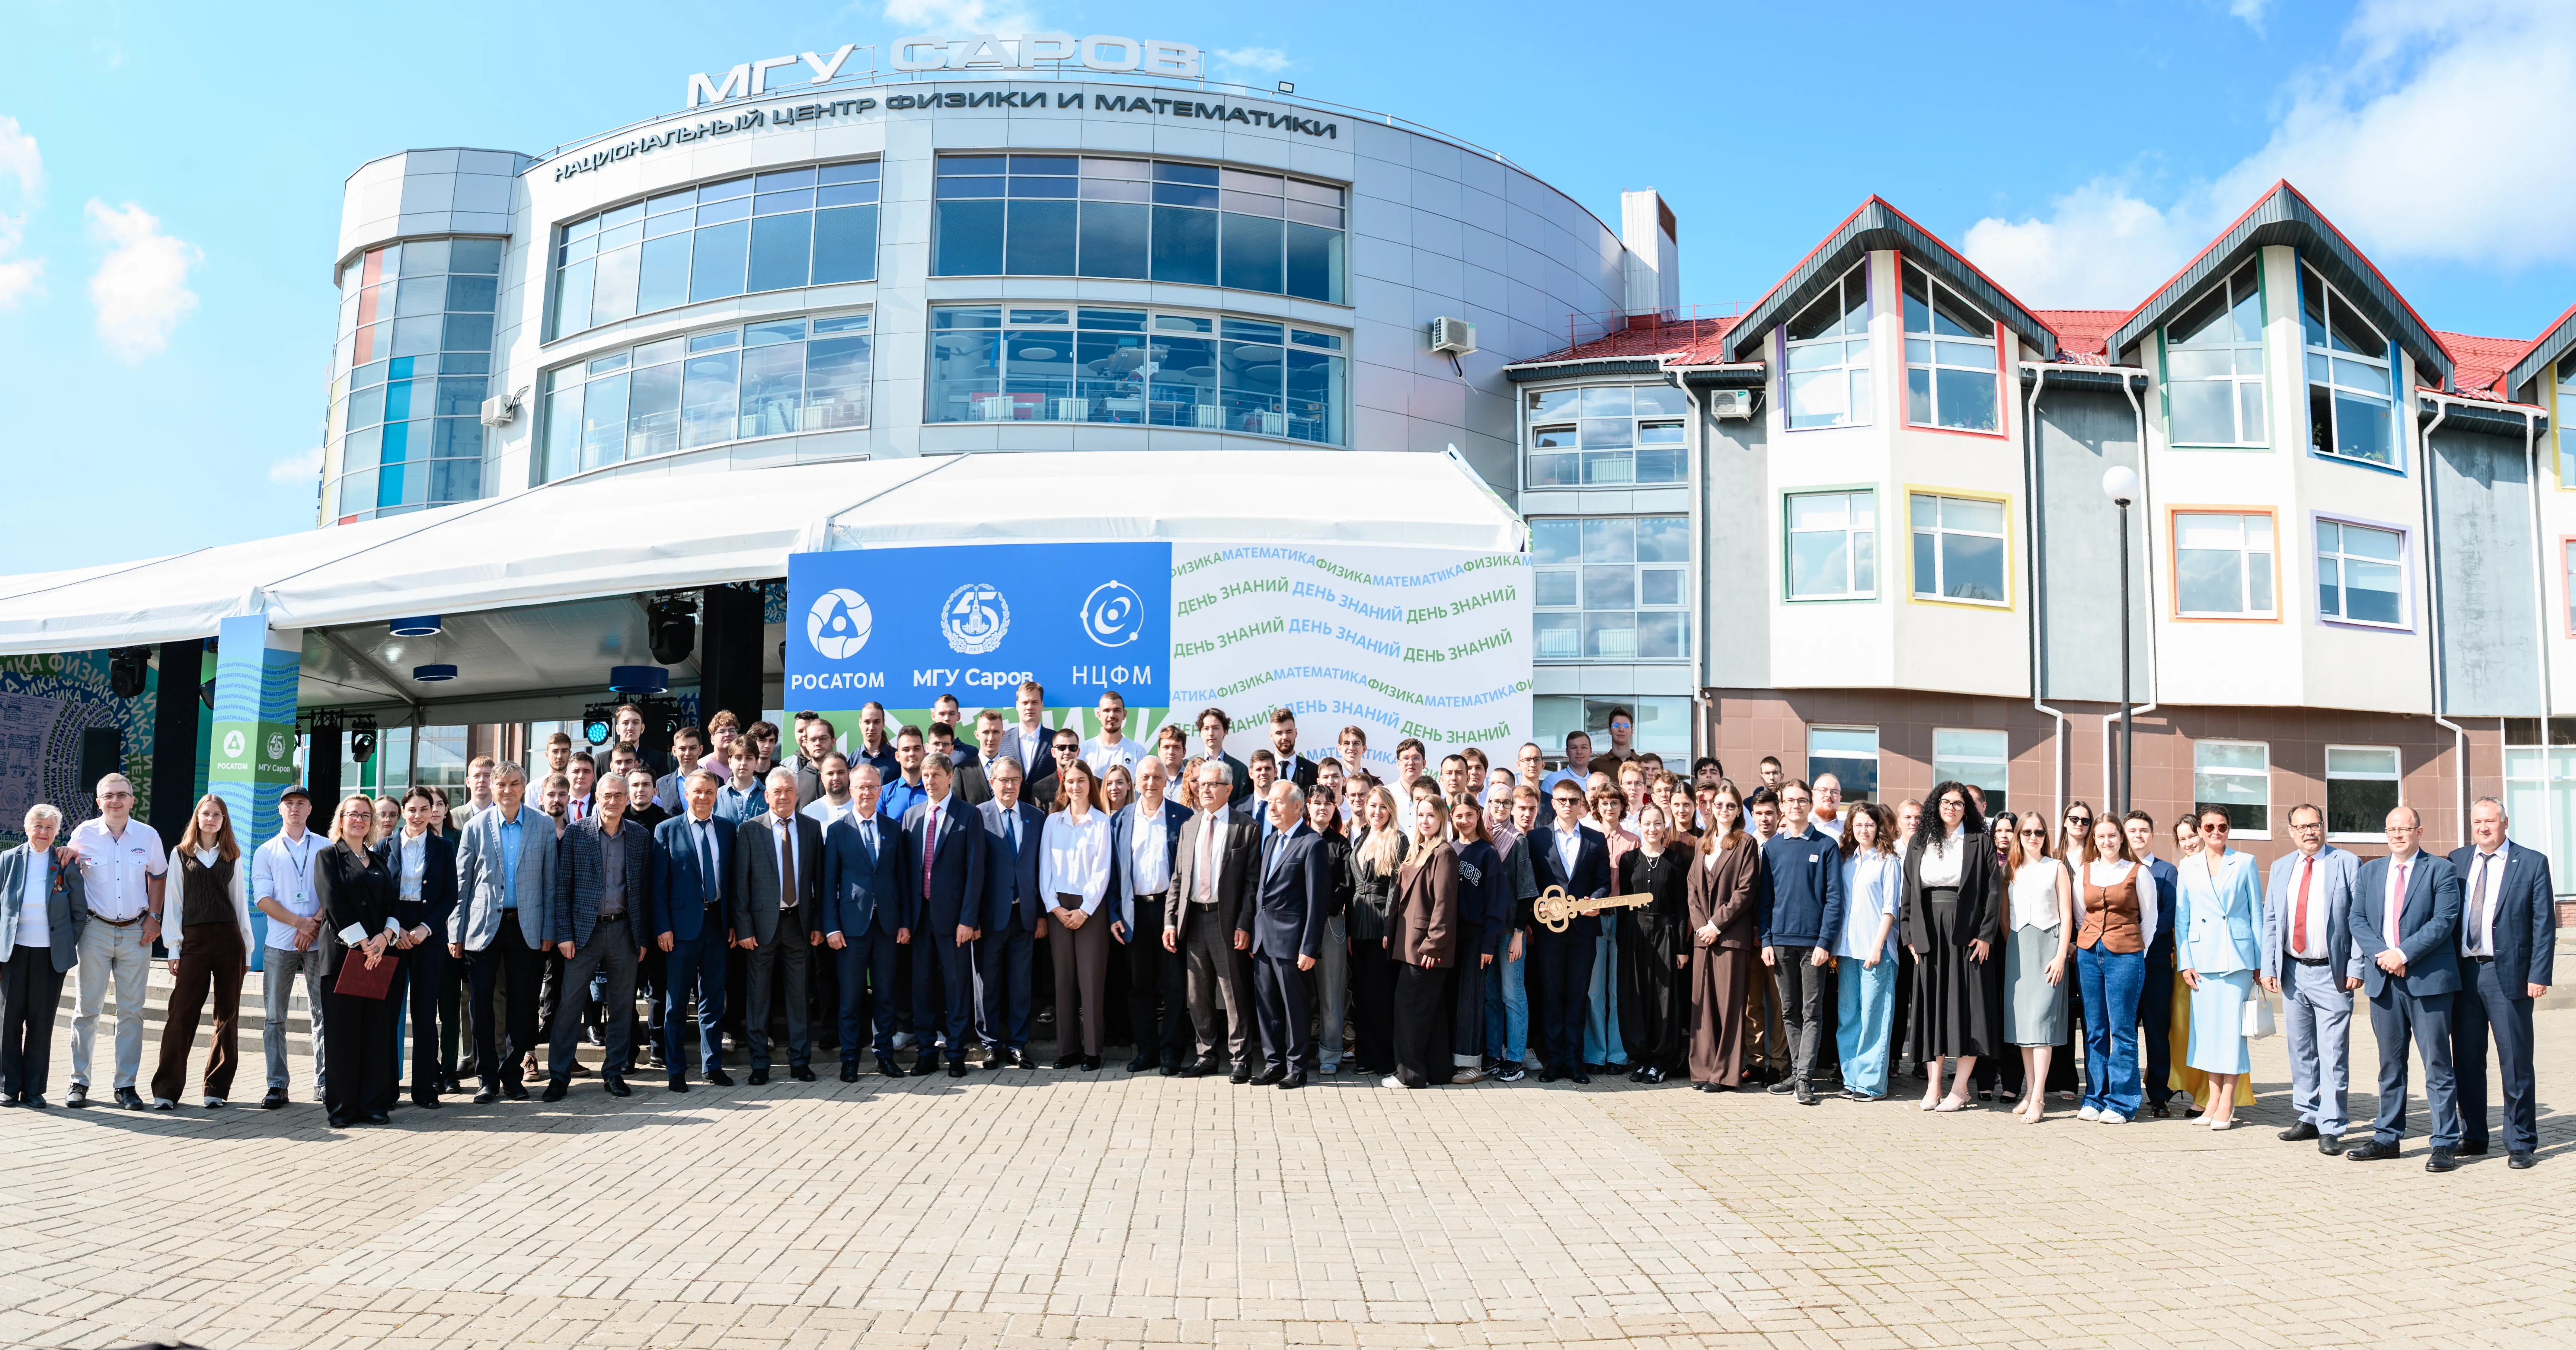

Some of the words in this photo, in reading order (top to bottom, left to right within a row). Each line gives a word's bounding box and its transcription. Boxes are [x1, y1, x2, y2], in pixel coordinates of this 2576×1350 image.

[687, 43, 857, 109] МГУ
[890, 33, 1200, 79] САРОВ
[554, 109, 763, 182] НАЦИОНАЛЬНЫЙ
[773, 97, 876, 125] ЦЕНТР
[885, 92, 1046, 109] ФИЗИКИ
[1058, 92, 1084, 109] И
[1096, 94, 1336, 139] МАТЕМАТИКИ
[1178, 593, 1217, 617] ДЕНЬ
[1220, 576, 1288, 599] ЗНАНИЙ
[1292, 581, 1335, 602] ДЕНЬ
[1338, 594, 1403, 622] ЗНАНИЙ
[1406, 606, 1448, 624] ДЕНЬ
[1450, 585, 1516, 615] ЗНАНИЙ
[1174, 639, 1215, 659] ДЕНЬ
[1217, 616, 1284, 648] ЗНАНИЙ
[1289, 618, 1332, 635] ДЕНЬ
[1335, 626, 1401, 658] ЗНАНИЙ
[1403, 647, 1445, 663] ДЕНЬ
[1448, 628, 1513, 660] ЗНАНИЙ
[792, 672, 885, 690] РОСАТОМ
[913, 669, 960, 687] МГУ
[965, 668, 1033, 690] Саров
[1073, 665, 1152, 688] НЦФМ
[46, 719, 62, 756] ФИЗИКА
[52, 704, 80, 763] МАТЕМАТИКА
[1332, 700, 1400, 729] ЗНАНИЙ
[1400, 720, 1442, 742] ДЕНЬ
[1447, 721, 1511, 743] ЗНАНИЙ
[272, 765, 290, 773] Саров
